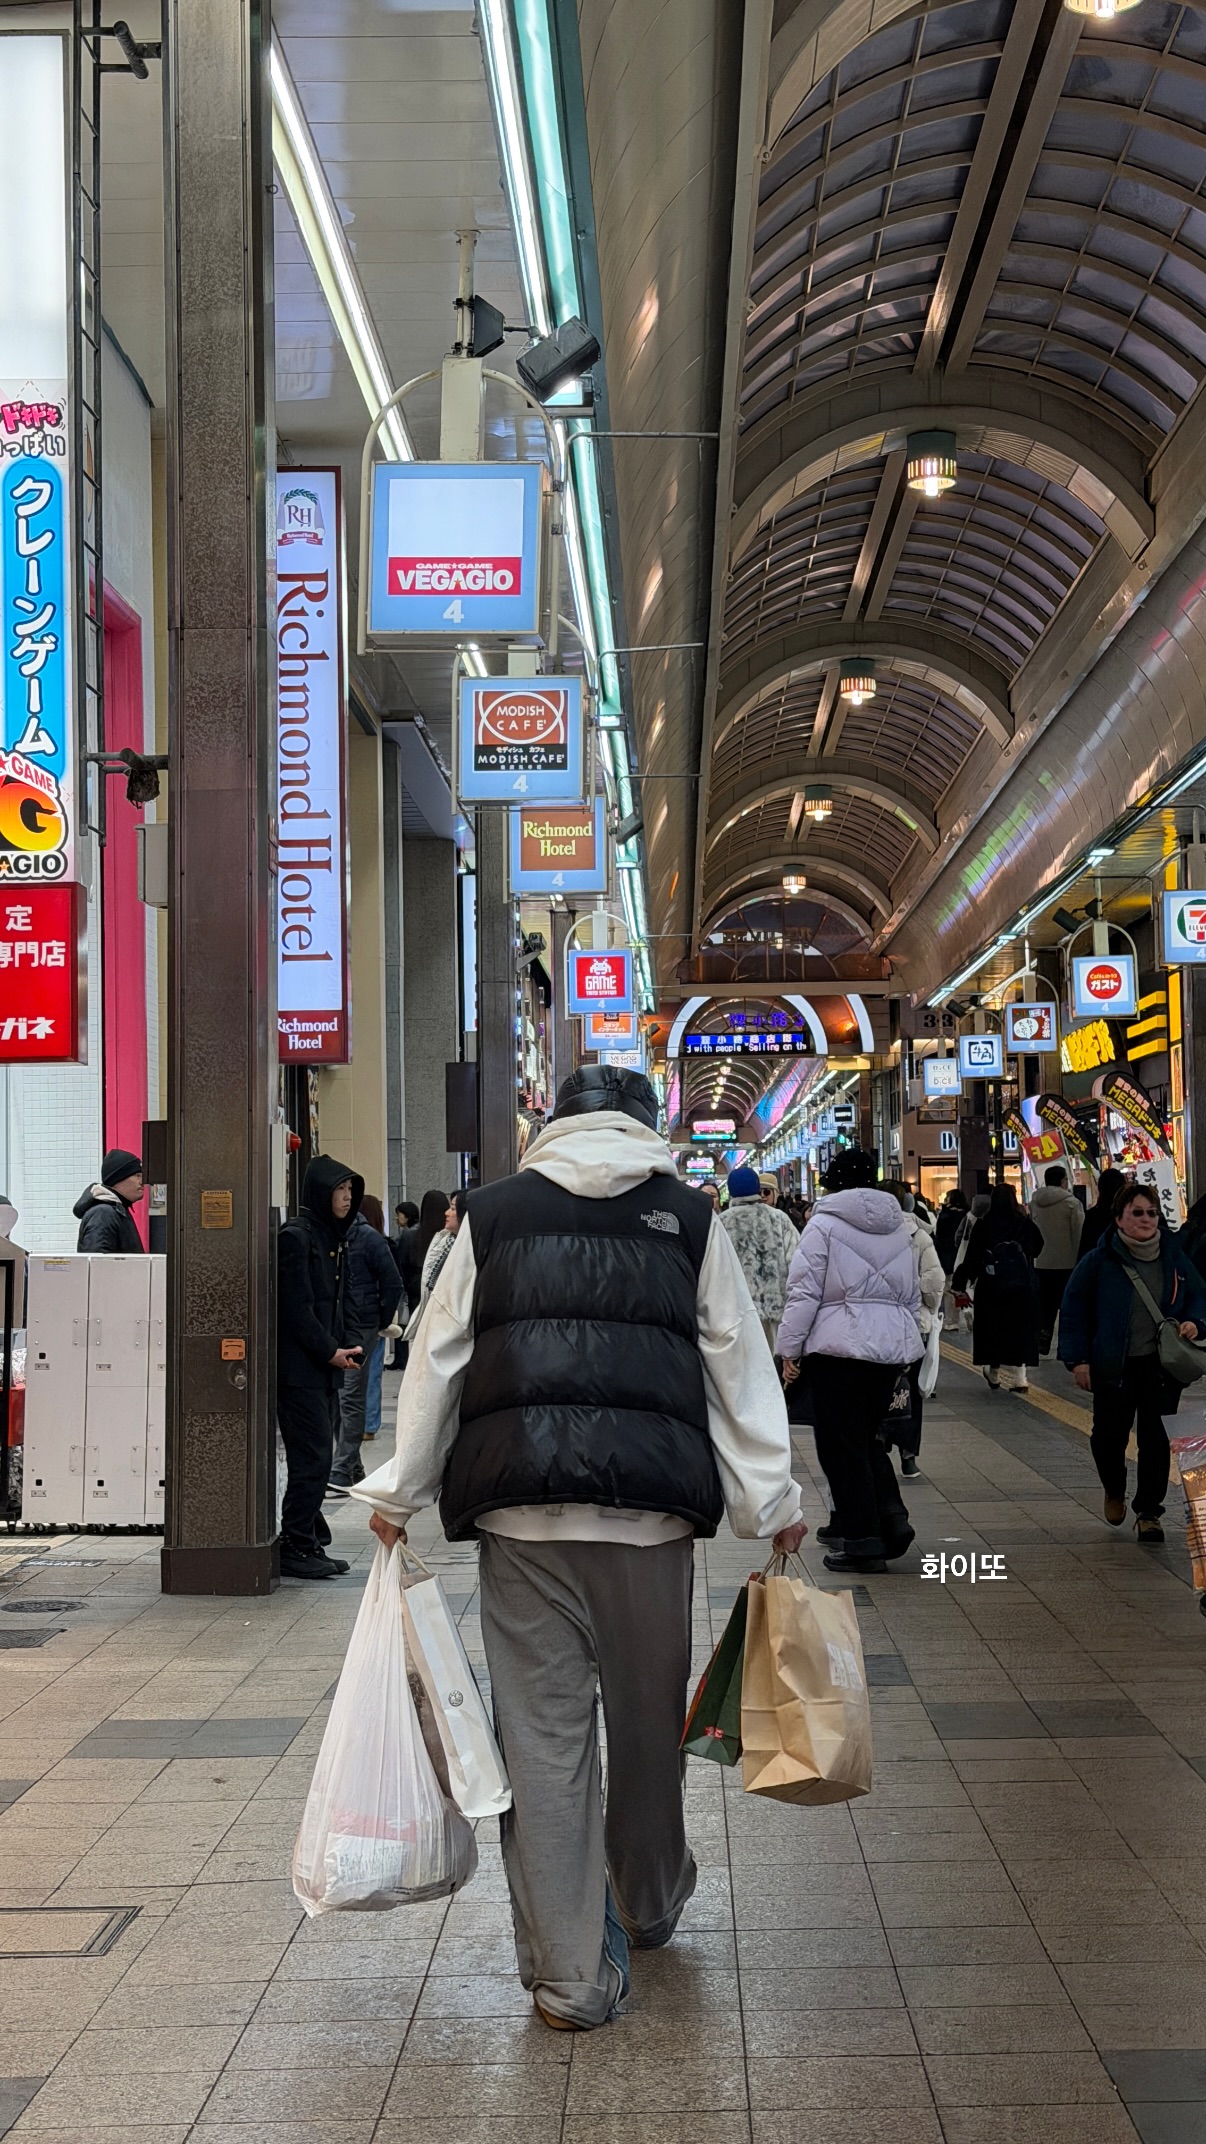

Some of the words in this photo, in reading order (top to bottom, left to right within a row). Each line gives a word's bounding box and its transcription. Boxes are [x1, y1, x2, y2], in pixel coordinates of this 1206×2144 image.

[2, 401, 61, 433] ドキドキ
[397, 570, 513, 590] VEGAGIO
[10, 476, 58, 755] クレーンゲーム
[443, 600, 464, 623] 4
[277, 568, 331, 824] Richmond
[496, 706, 544, 716] MODISH
[478, 755, 528, 764] MODISH
[12, 756, 54, 793] GAME
[513, 775, 528, 792] 4
[523, 821, 593, 838] Richmond
[540, 839, 576, 856] Hotel
[552, 873, 564, 886] 4
[277, 835, 333, 965] Hotel
[1196, 948, 1205, 958] 4
[585, 975, 616, 990] GAME
[1091, 979, 1119, 990] ガスト
[598, 1000, 605, 1008] 4
[1102, 1003, 1109, 1011] 4
[0, 1017, 56, 1040] ガネ
[288, 1034, 322, 1050] Hotel
[1108, 1085, 1162, 1139] MEGAドンキ
[1040, 1106, 1088, 1152] MEGAドンキ
[652, 1210, 668, 1219] THE
